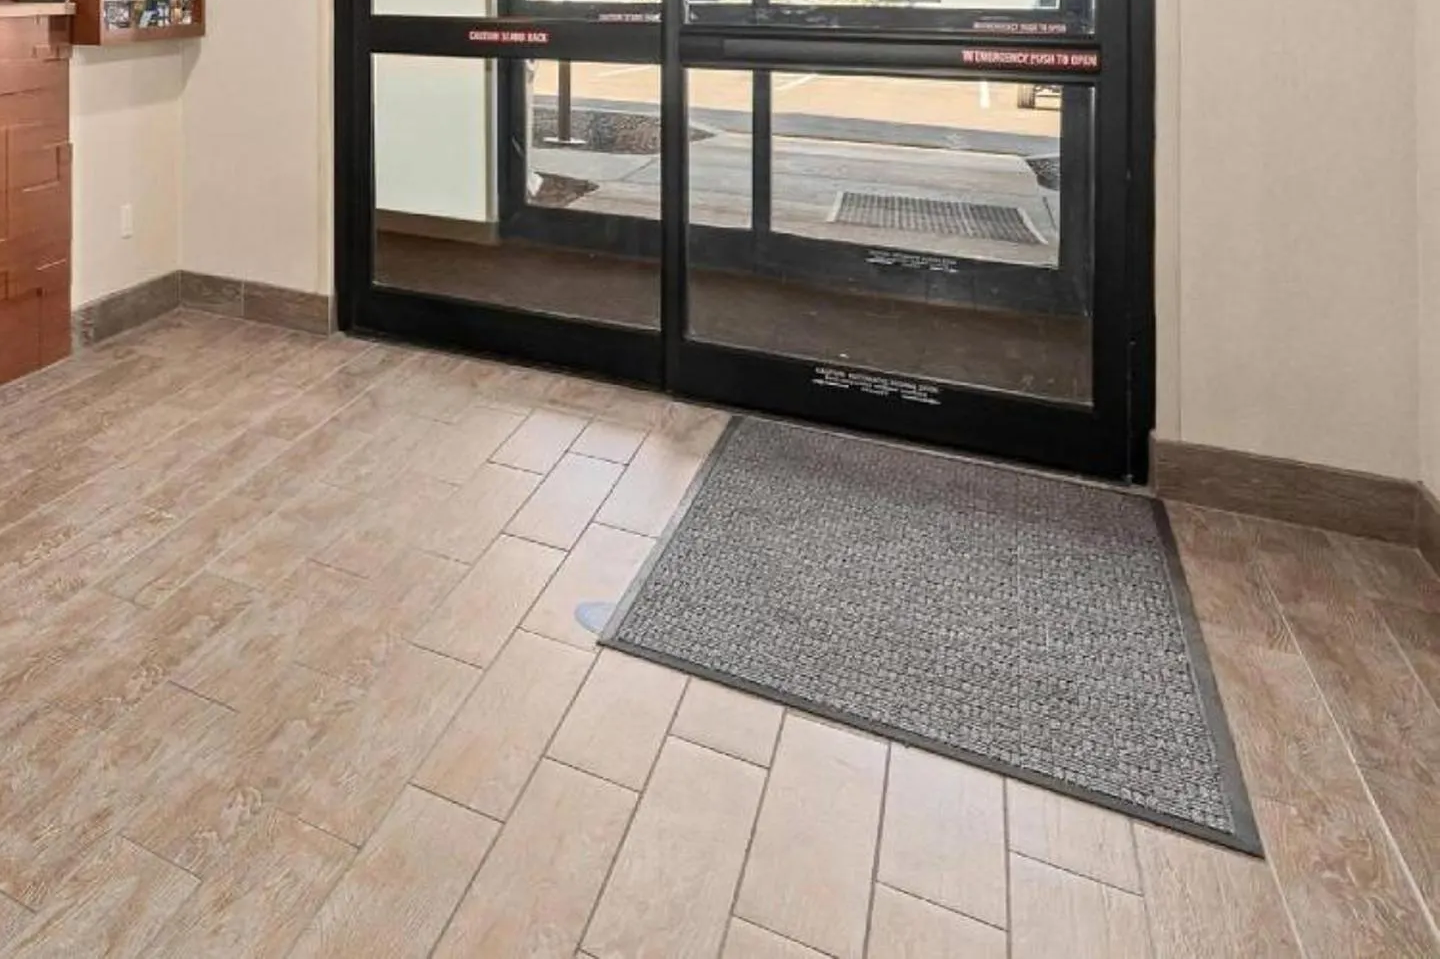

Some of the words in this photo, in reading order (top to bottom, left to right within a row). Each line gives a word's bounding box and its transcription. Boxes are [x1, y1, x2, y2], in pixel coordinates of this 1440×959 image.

[962, 50, 974, 62] IN
[975, 50, 1028, 64] EMERGENCY
[1030, 53, 1055, 65] PUSH
[1057, 53, 1069, 66] TO
[1071, 54, 1098, 67] OPEN
